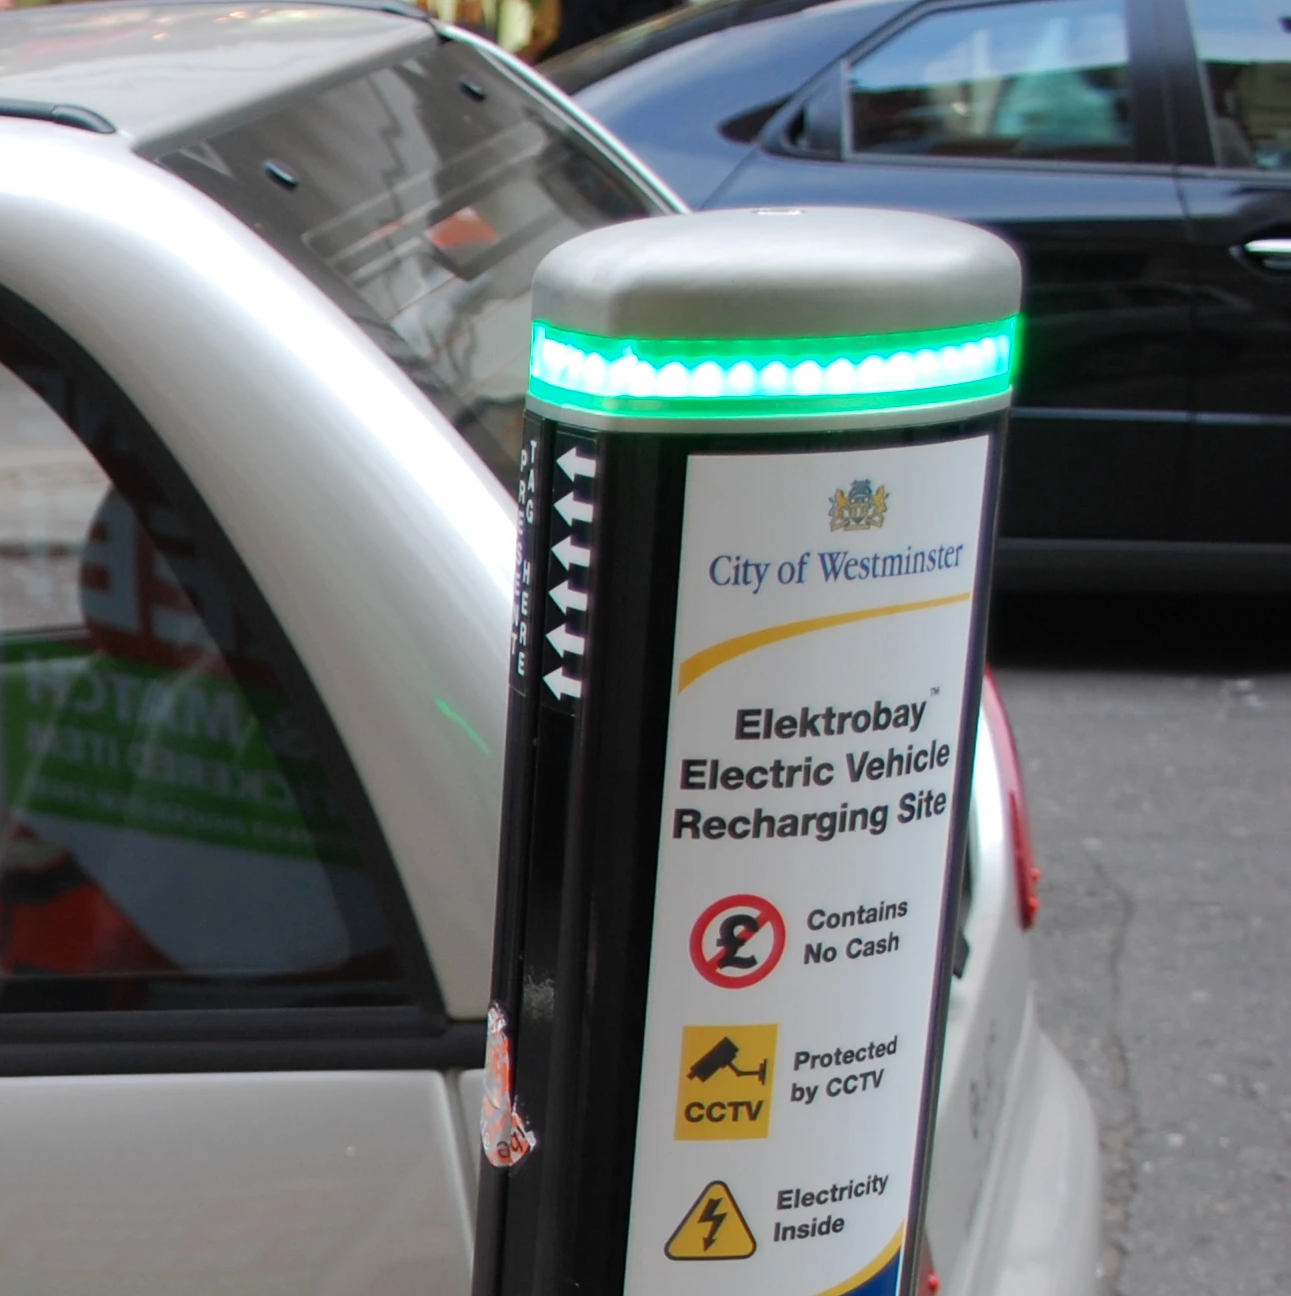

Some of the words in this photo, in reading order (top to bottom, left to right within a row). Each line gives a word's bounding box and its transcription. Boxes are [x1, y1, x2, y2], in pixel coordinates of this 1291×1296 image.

[524, 439, 538, 526] TAG
[509, 449, 528, 656] PRESENT
[708, 555, 771, 595] City
[777, 551, 812, 585] of
[816, 542, 964, 583] Westminster
[516, 560, 532, 676] HERE
[734, 700, 927, 740] Elektrobay
[679, 757, 835, 791] Electric
[845, 738, 950, 783] Vehicle
[672, 802, 890, 842] Recharging
[897, 789, 947, 827] Site
[806, 899, 908, 932] Contains
[803, 942, 837, 965] No
[845, 931, 900, 960] Cash
[793, 1035, 898, 1072] Protected
[790, 1082, 819, 1105] by
[825, 1068, 885, 1098] CCTV
[683, 1099, 764, 1124] CCTV
[776, 1172, 889, 1211] Electricity
[773, 1214, 845, 1243] Inside
